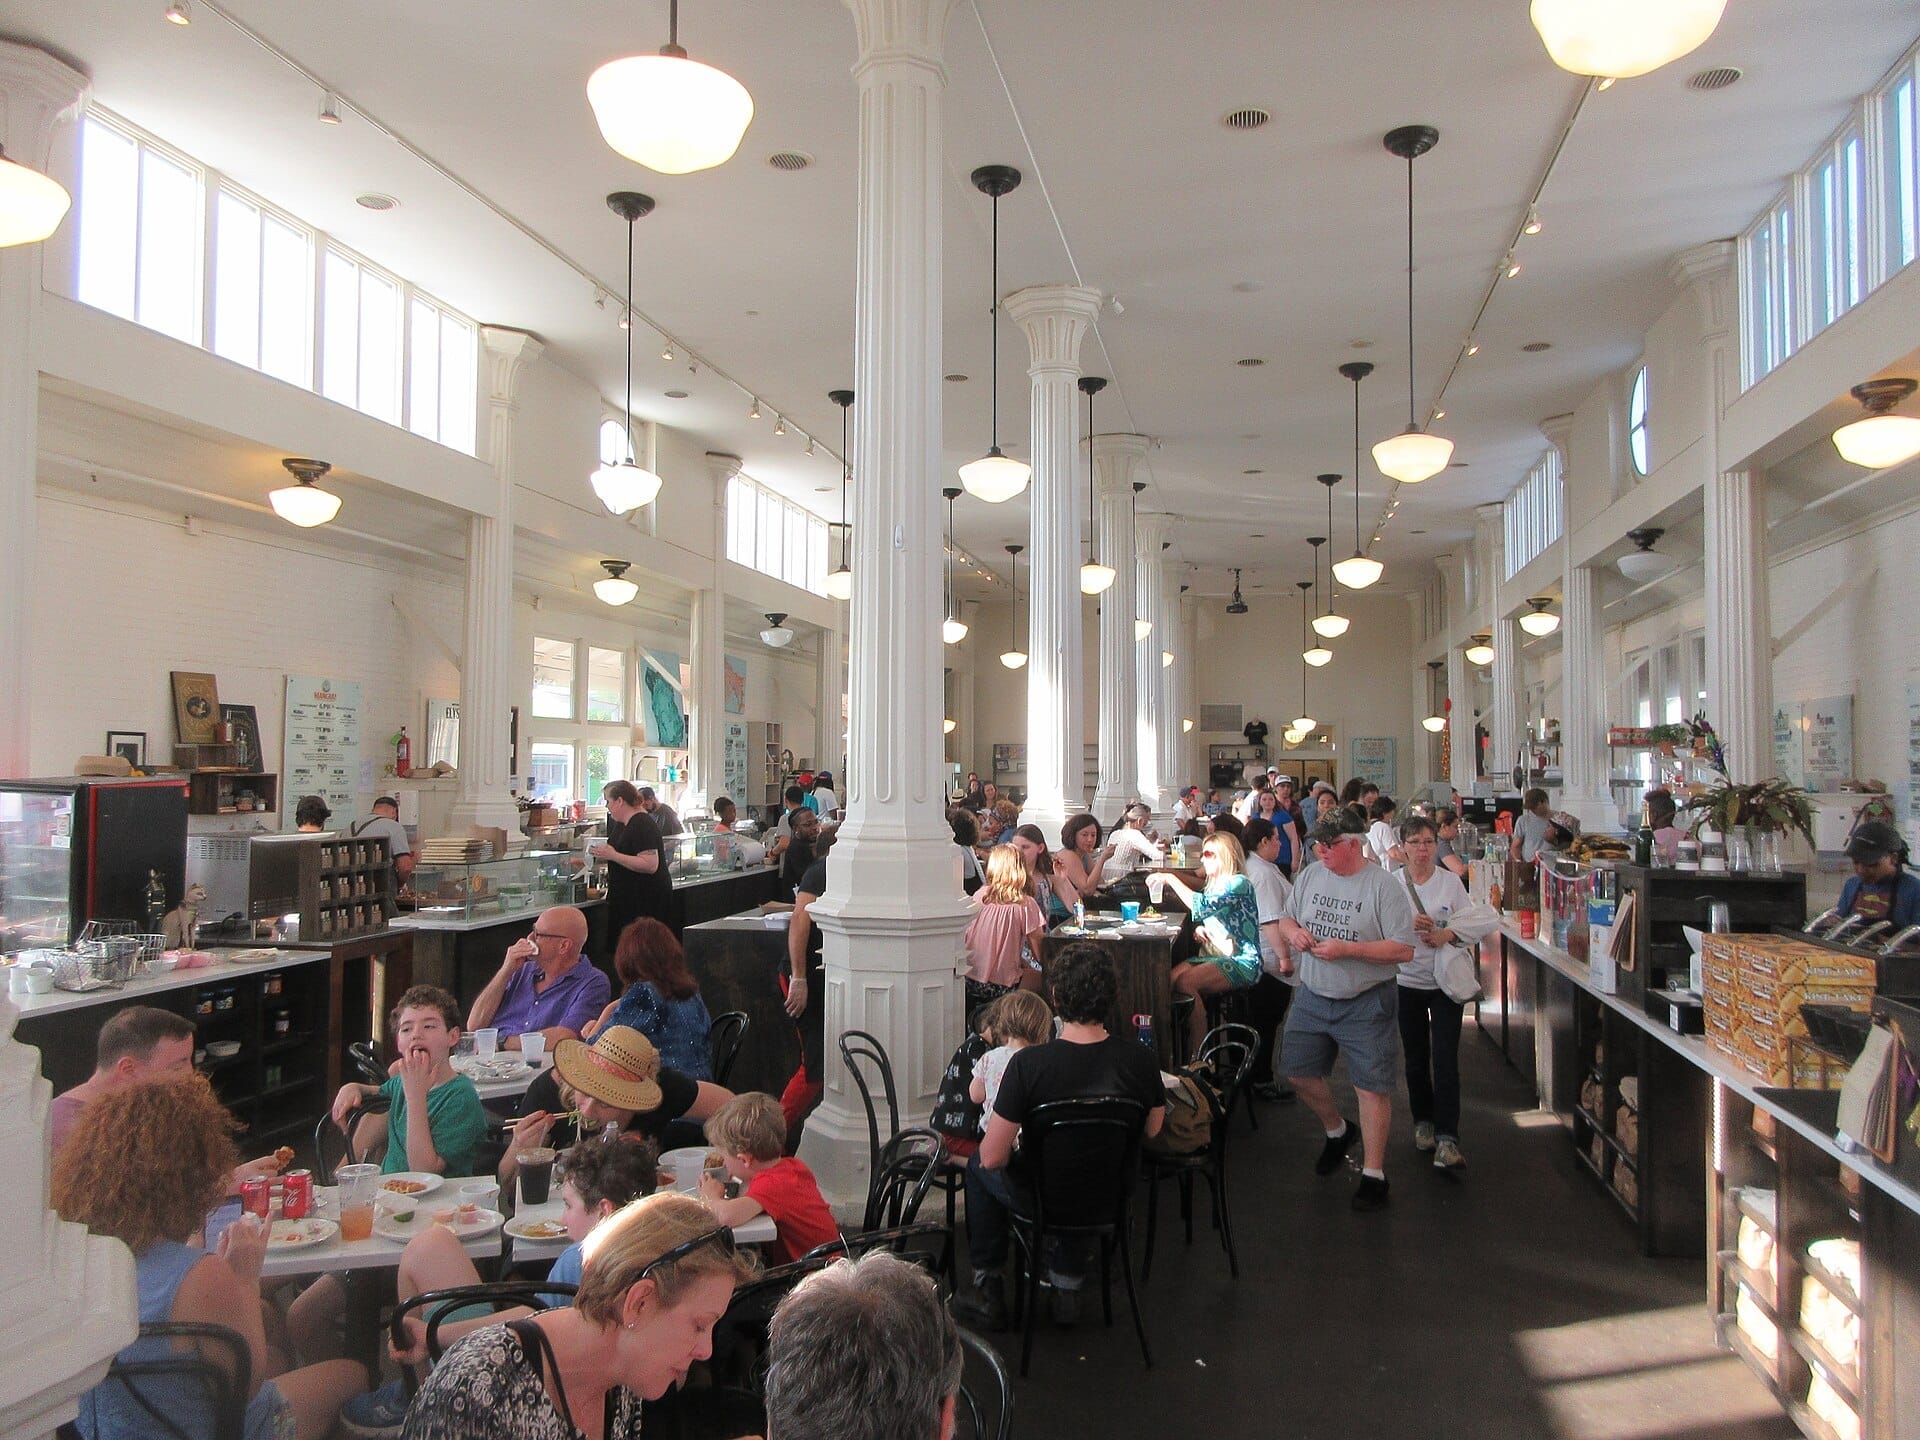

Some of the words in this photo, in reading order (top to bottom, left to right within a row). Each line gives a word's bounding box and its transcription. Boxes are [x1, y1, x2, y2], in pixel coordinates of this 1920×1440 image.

[1319, 895, 1341, 909] OUT
[1340, 899, 1354, 911] OF
[1355, 901, 1363, 913] 4
[1315, 909, 1351, 926] PEOPLE
[1305, 921, 1359, 942] STRUGGLE
